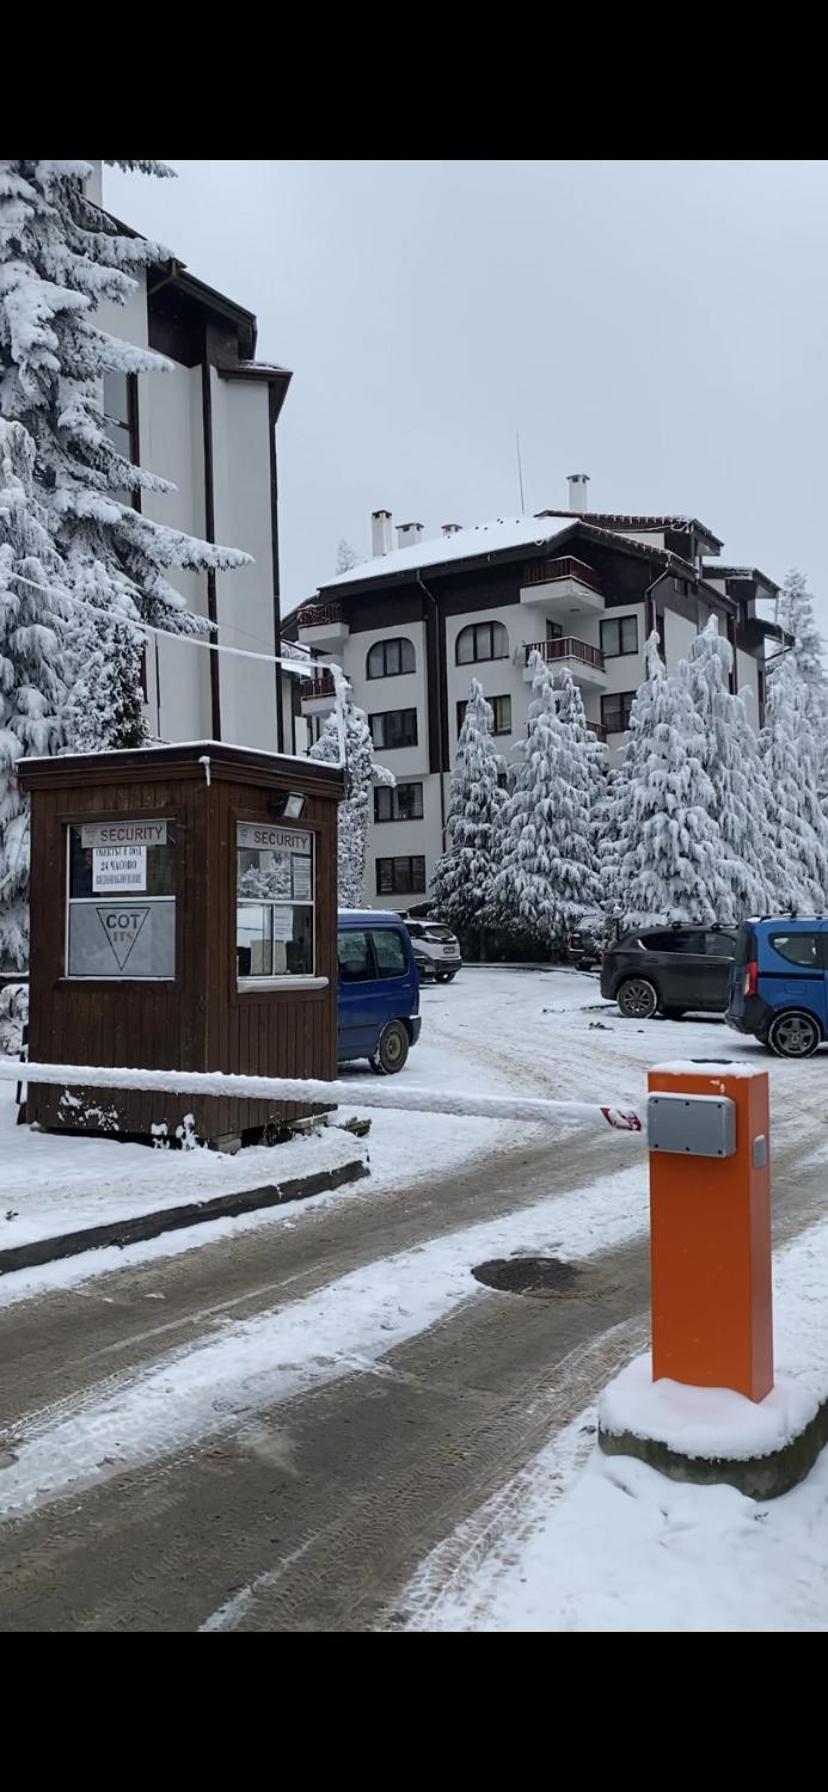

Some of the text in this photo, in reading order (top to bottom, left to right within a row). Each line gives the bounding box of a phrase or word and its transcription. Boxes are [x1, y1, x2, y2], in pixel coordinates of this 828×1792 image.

[100, 826, 163, 842] SECURITY
[254, 831, 308, 848] SECURITY
[100, 861, 109, 872] 24
